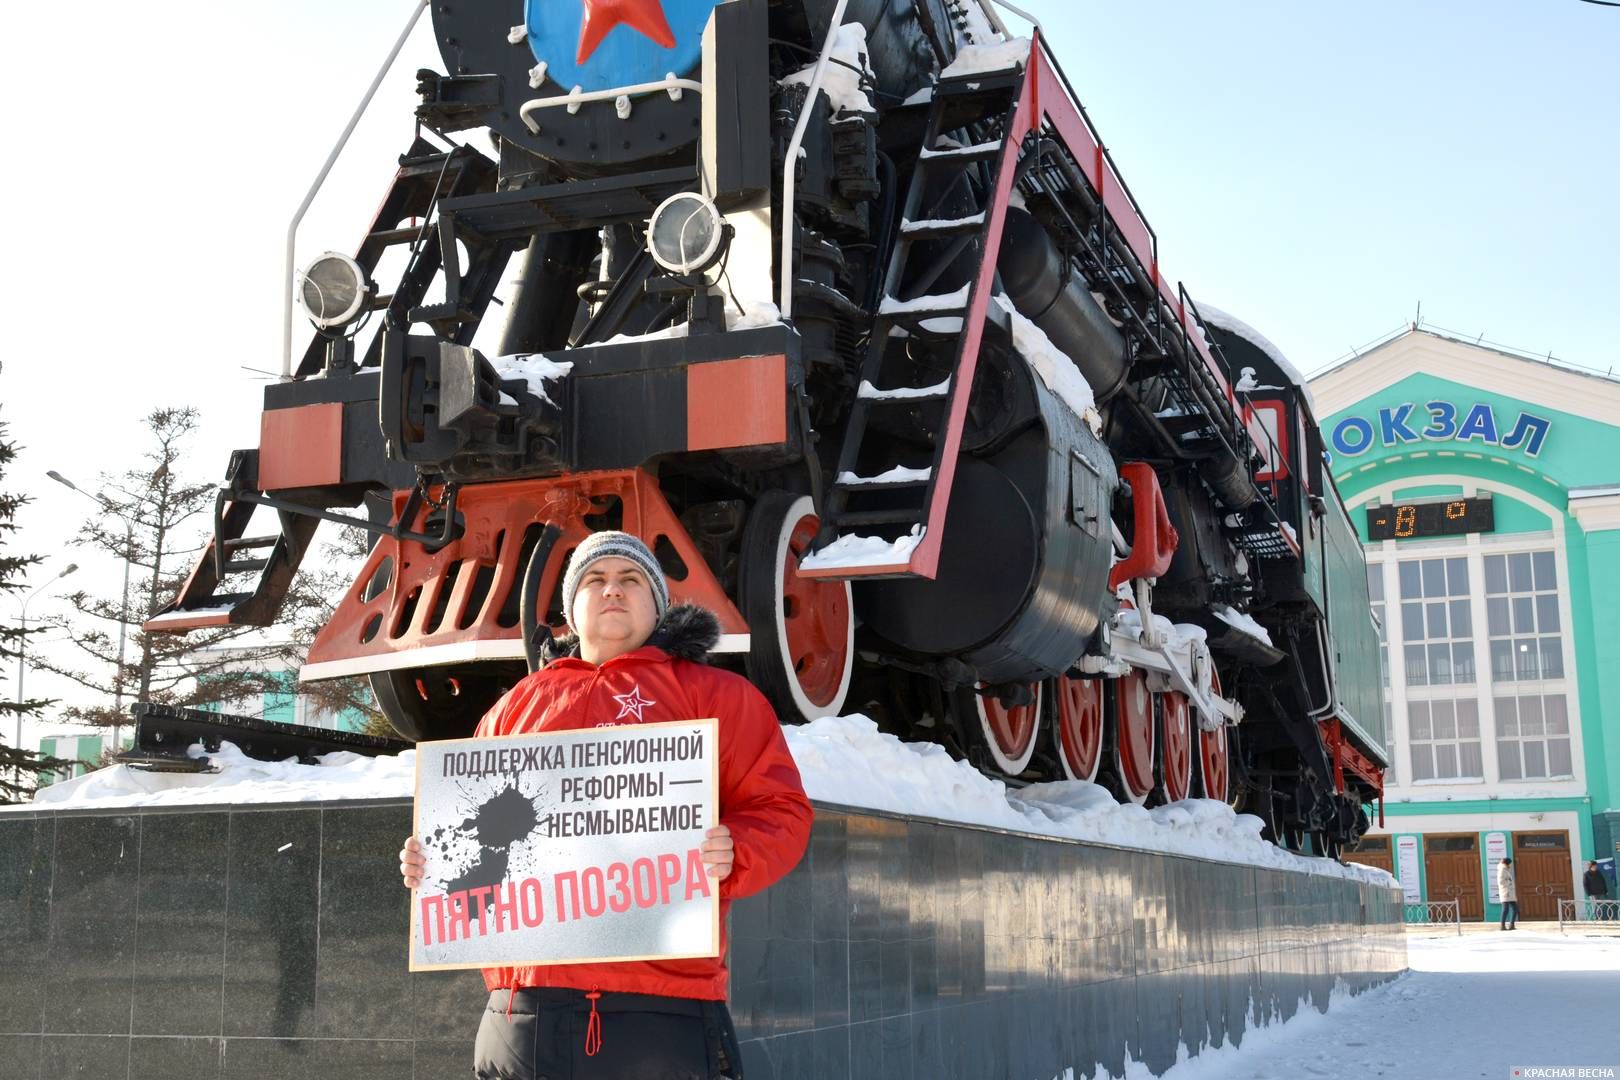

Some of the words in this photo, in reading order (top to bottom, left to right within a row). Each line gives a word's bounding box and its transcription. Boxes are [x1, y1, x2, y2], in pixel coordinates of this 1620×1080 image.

[1322, 400, 1552, 468] ОКЗАЛ
[443, 745, 565, 777] ПОДДЕРЖКА
[571, 730, 703, 768] ПЕНСИОННОЙ
[561, 772, 664, 802] РЕФОРМЫ
[549, 804, 703, 838] НЕСМЫВАЕМОЕ
[420, 878, 544, 946] ПЯТНО
[554, 848, 711, 922] ПОЗОРА
